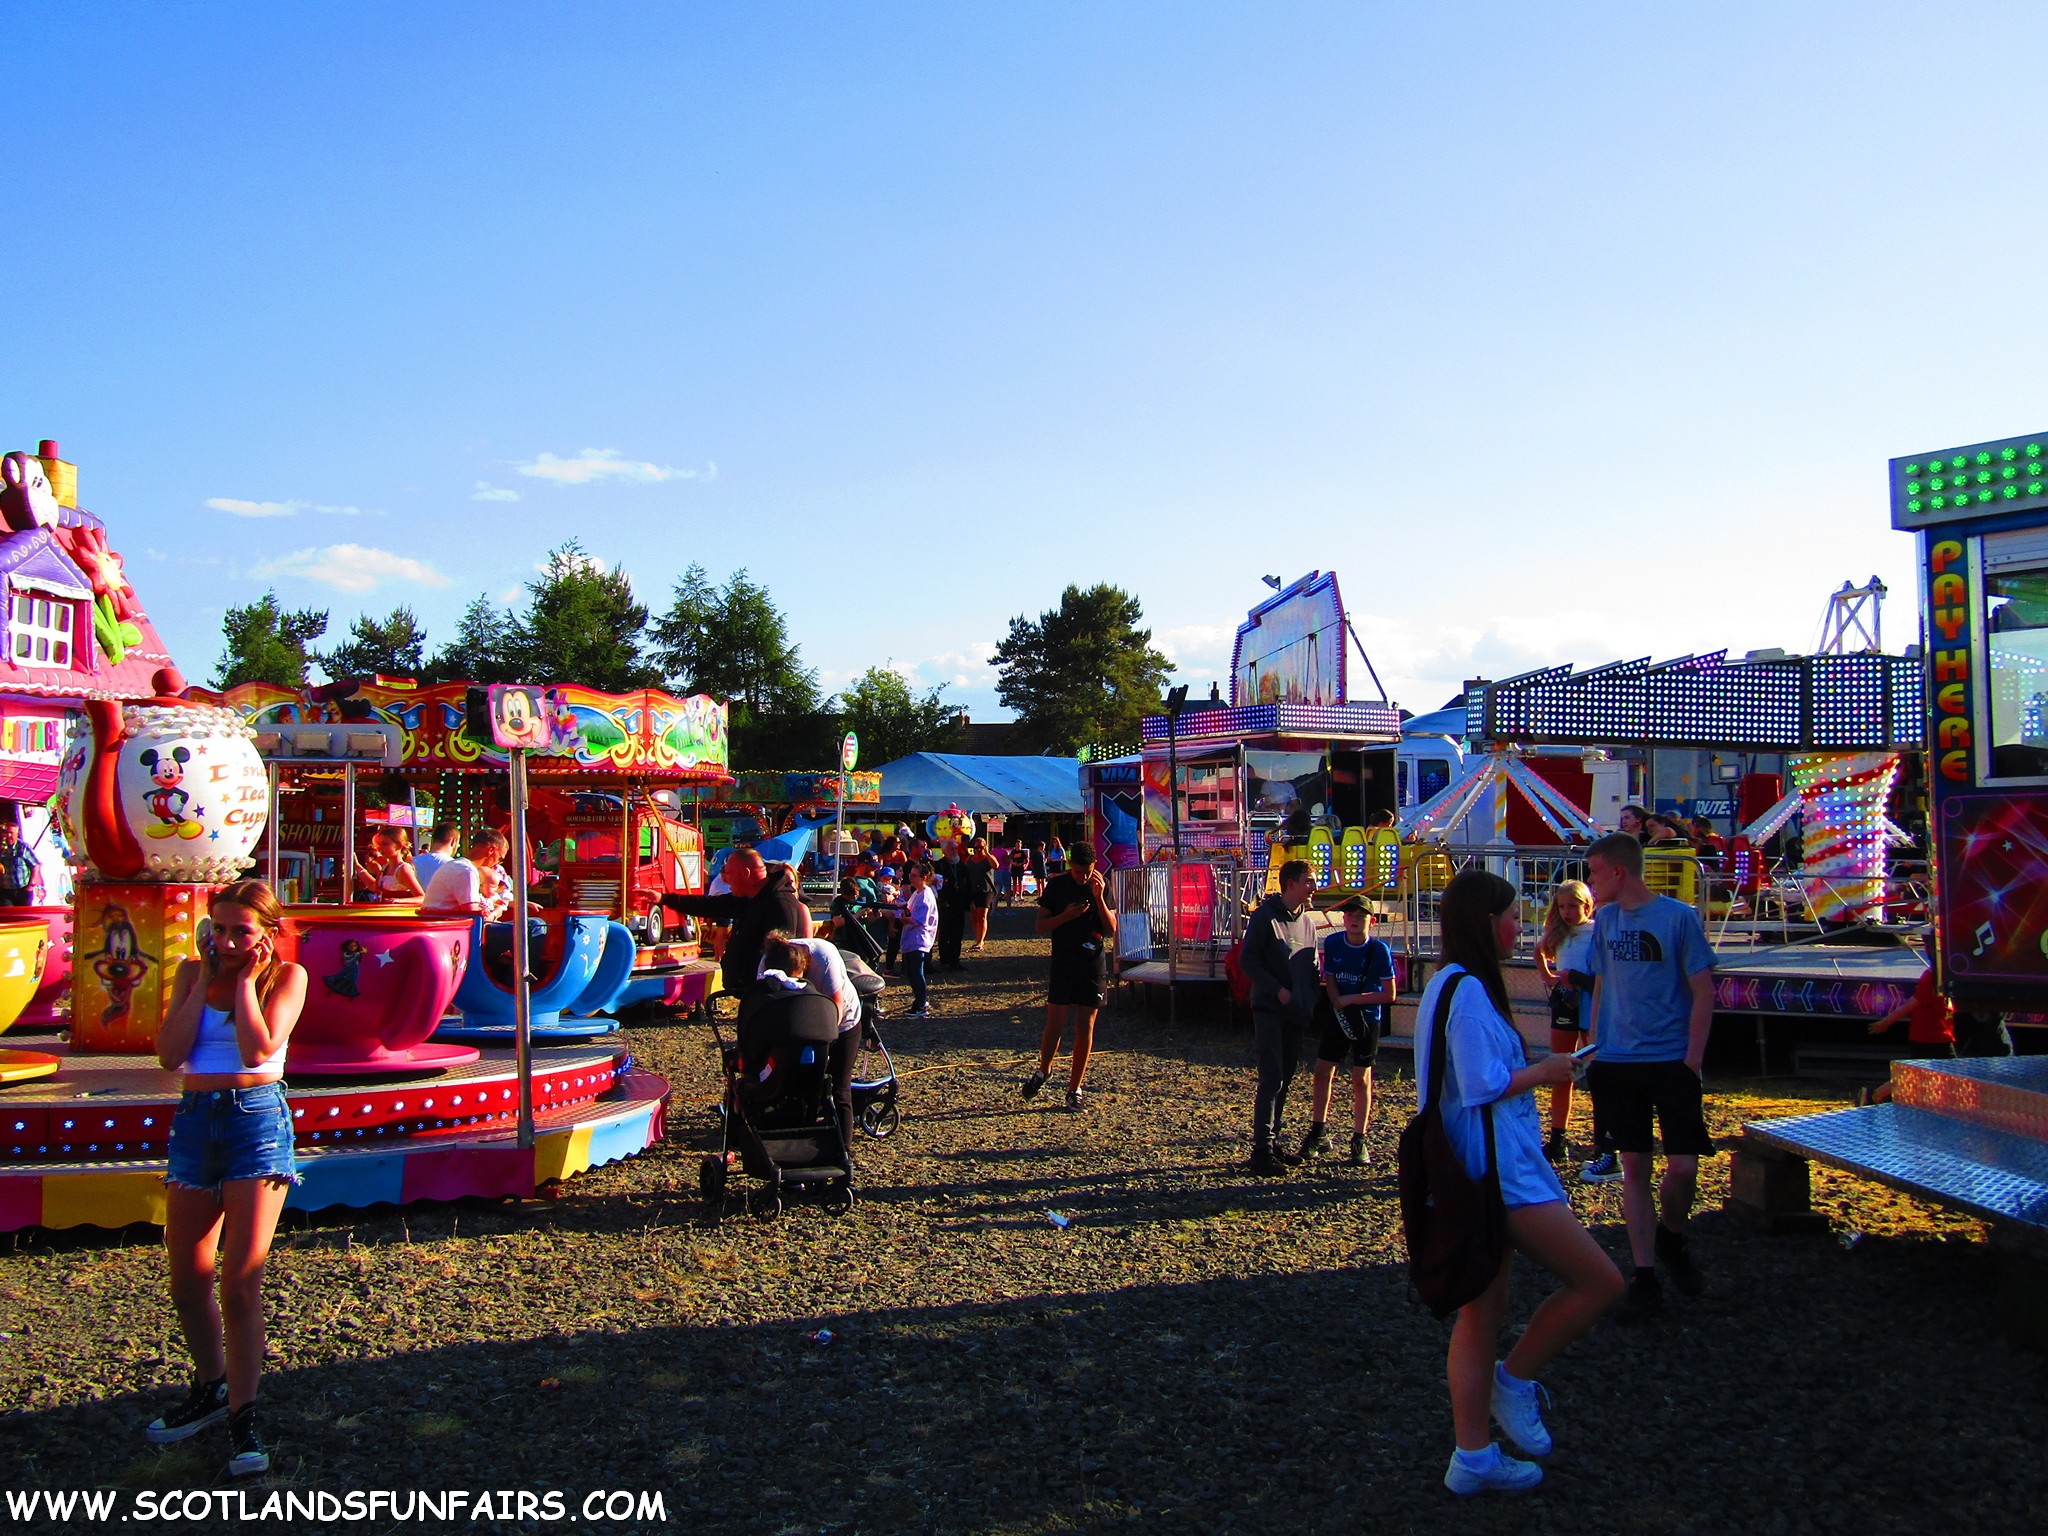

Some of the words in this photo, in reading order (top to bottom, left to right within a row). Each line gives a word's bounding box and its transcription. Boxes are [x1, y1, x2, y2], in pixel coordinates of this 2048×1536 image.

[1932, 540, 1965, 640] PAY
[1935, 649, 1971, 782] HERE
[2, 718, 59, 752] COTTAGE
[1101, 766, 1137, 782] VIVA
[236, 786, 265, 802] Tea
[1620, 930, 1639, 941] THE
[1607, 940, 1639, 951] NORTH
[1613, 950, 1639, 961] FACE
